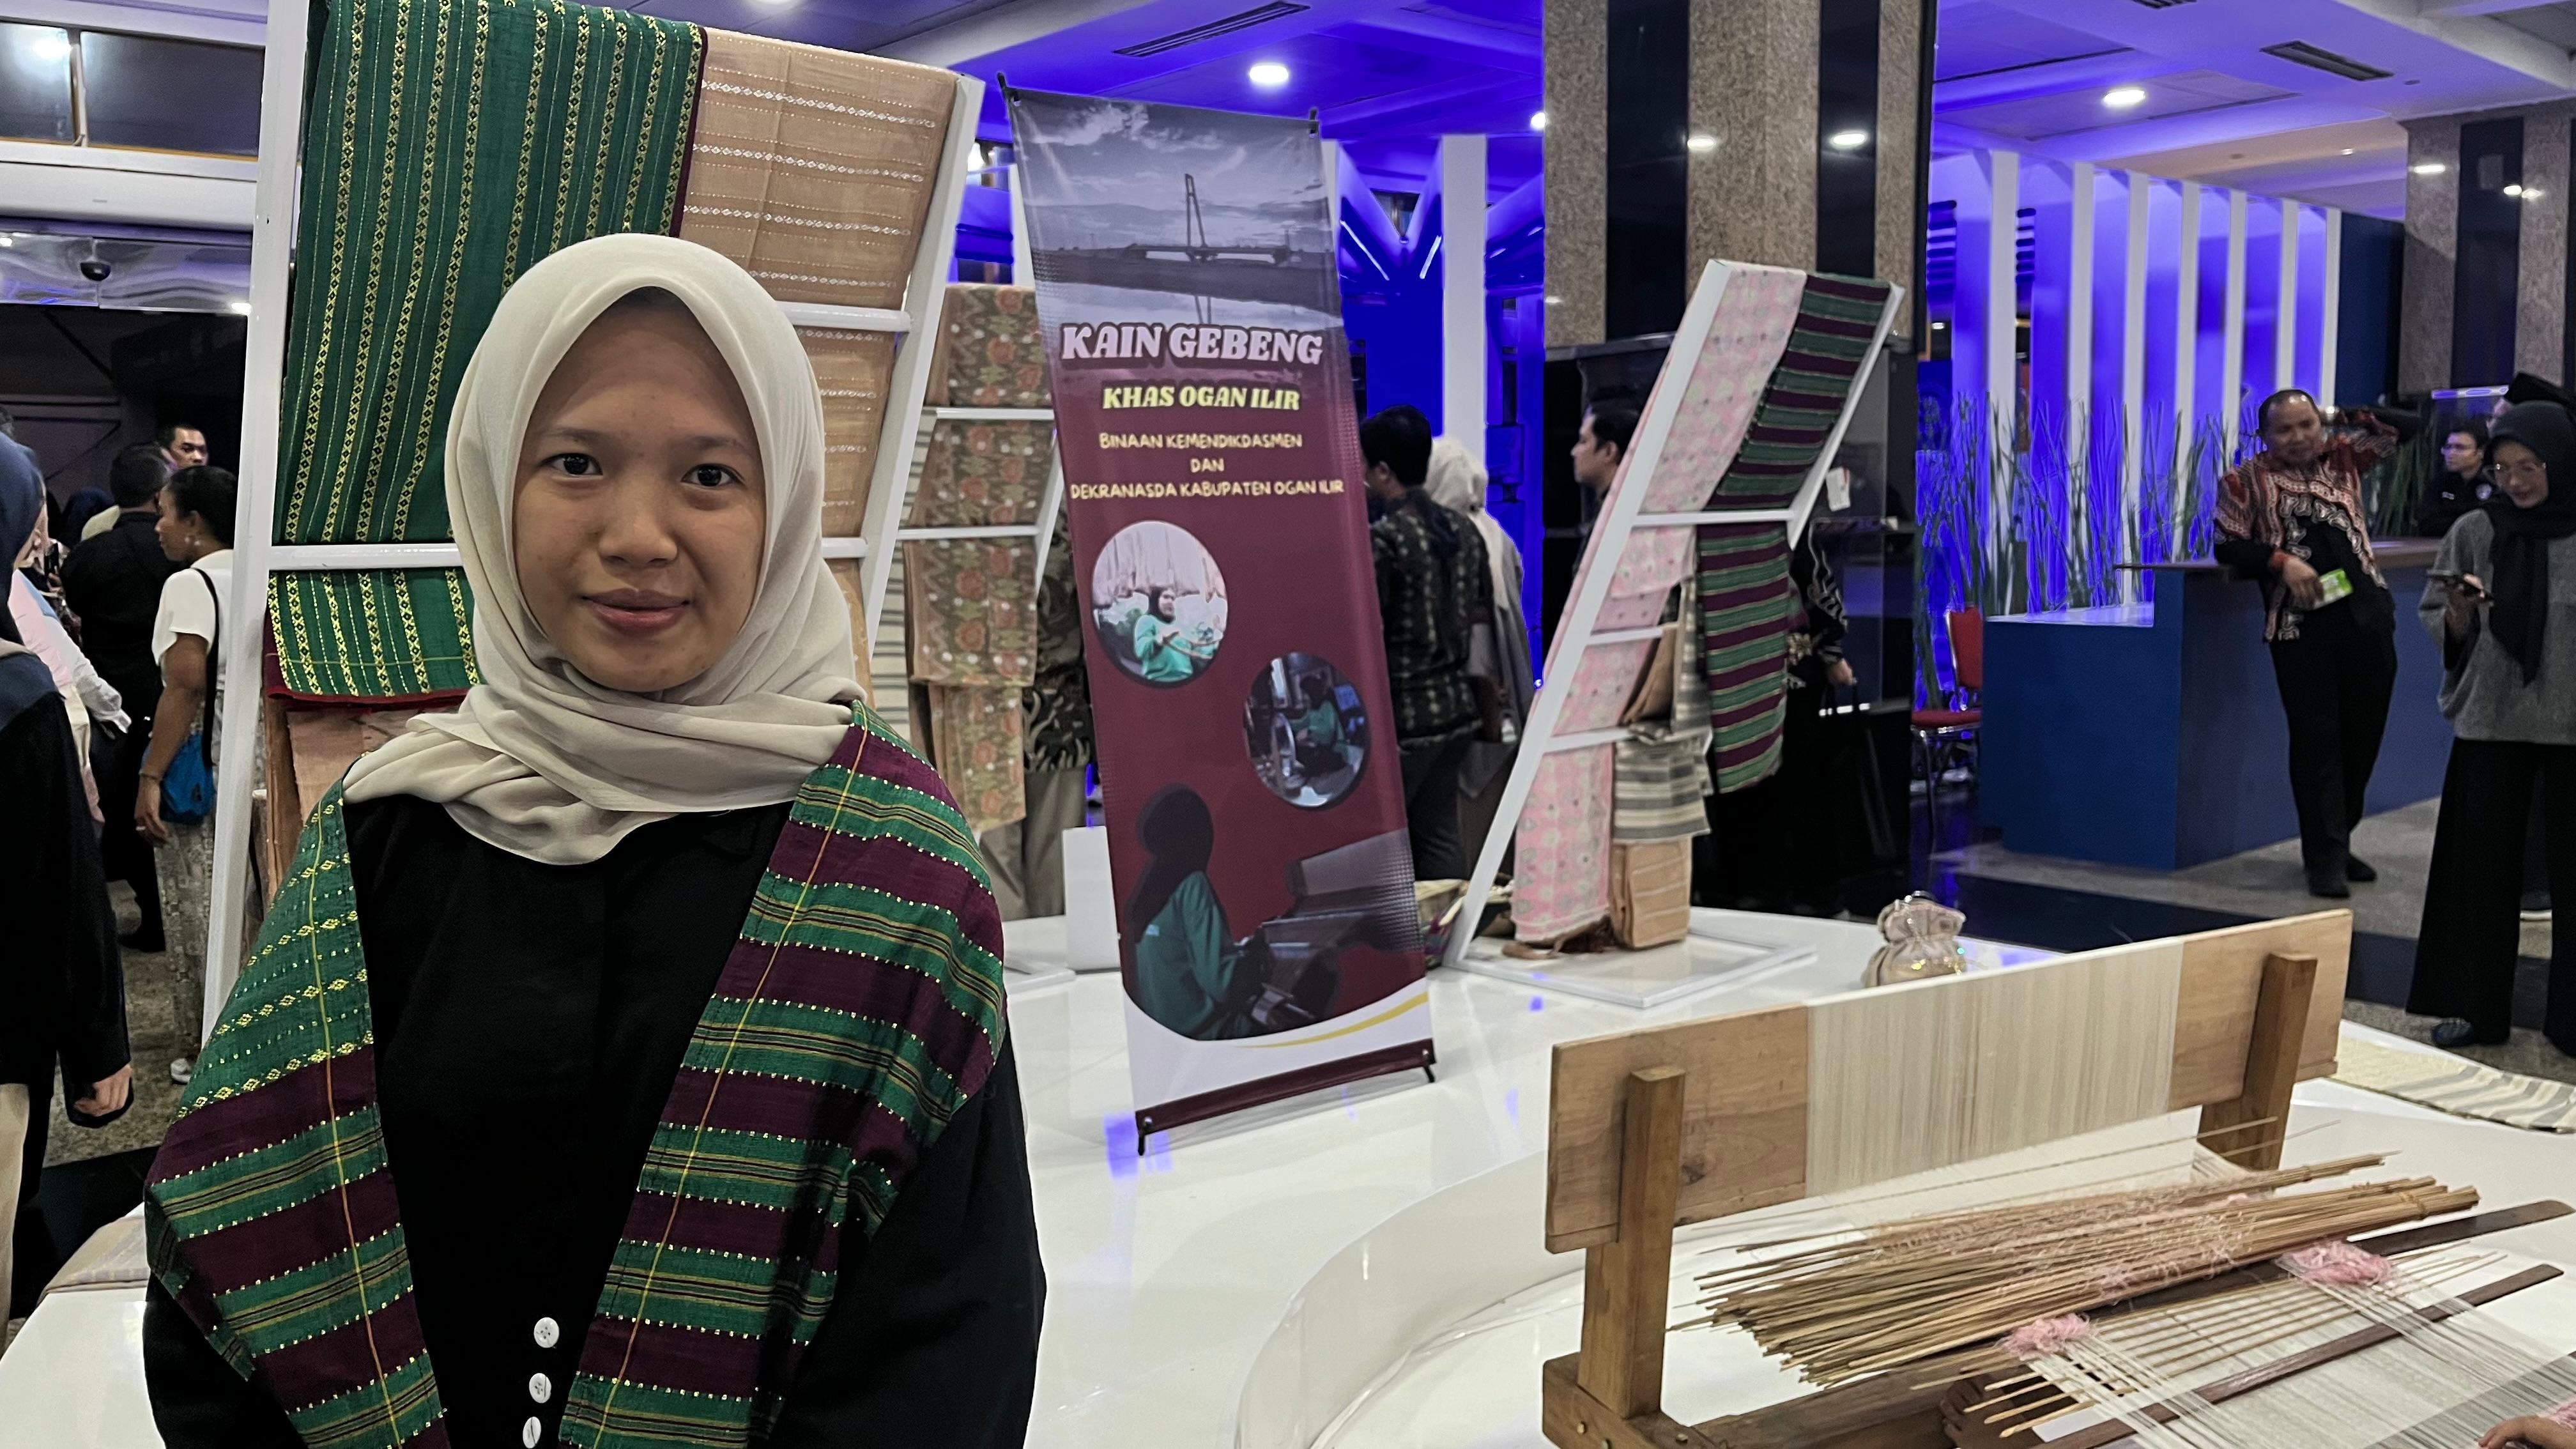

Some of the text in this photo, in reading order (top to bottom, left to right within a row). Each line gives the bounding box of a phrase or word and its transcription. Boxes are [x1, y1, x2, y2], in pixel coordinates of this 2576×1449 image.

[1062, 326, 1322, 365] KAIN GEBENG
[1103, 385, 1300, 411] KHAS OGAN ILIR
[1099, 433, 1303, 448] BINAAN KEMENDIKDASMEN
[1190, 458, 1225, 473] DAN
[1070, 479, 1345, 499] DEKRANASDA KABUPATEN OGAN ILIR
